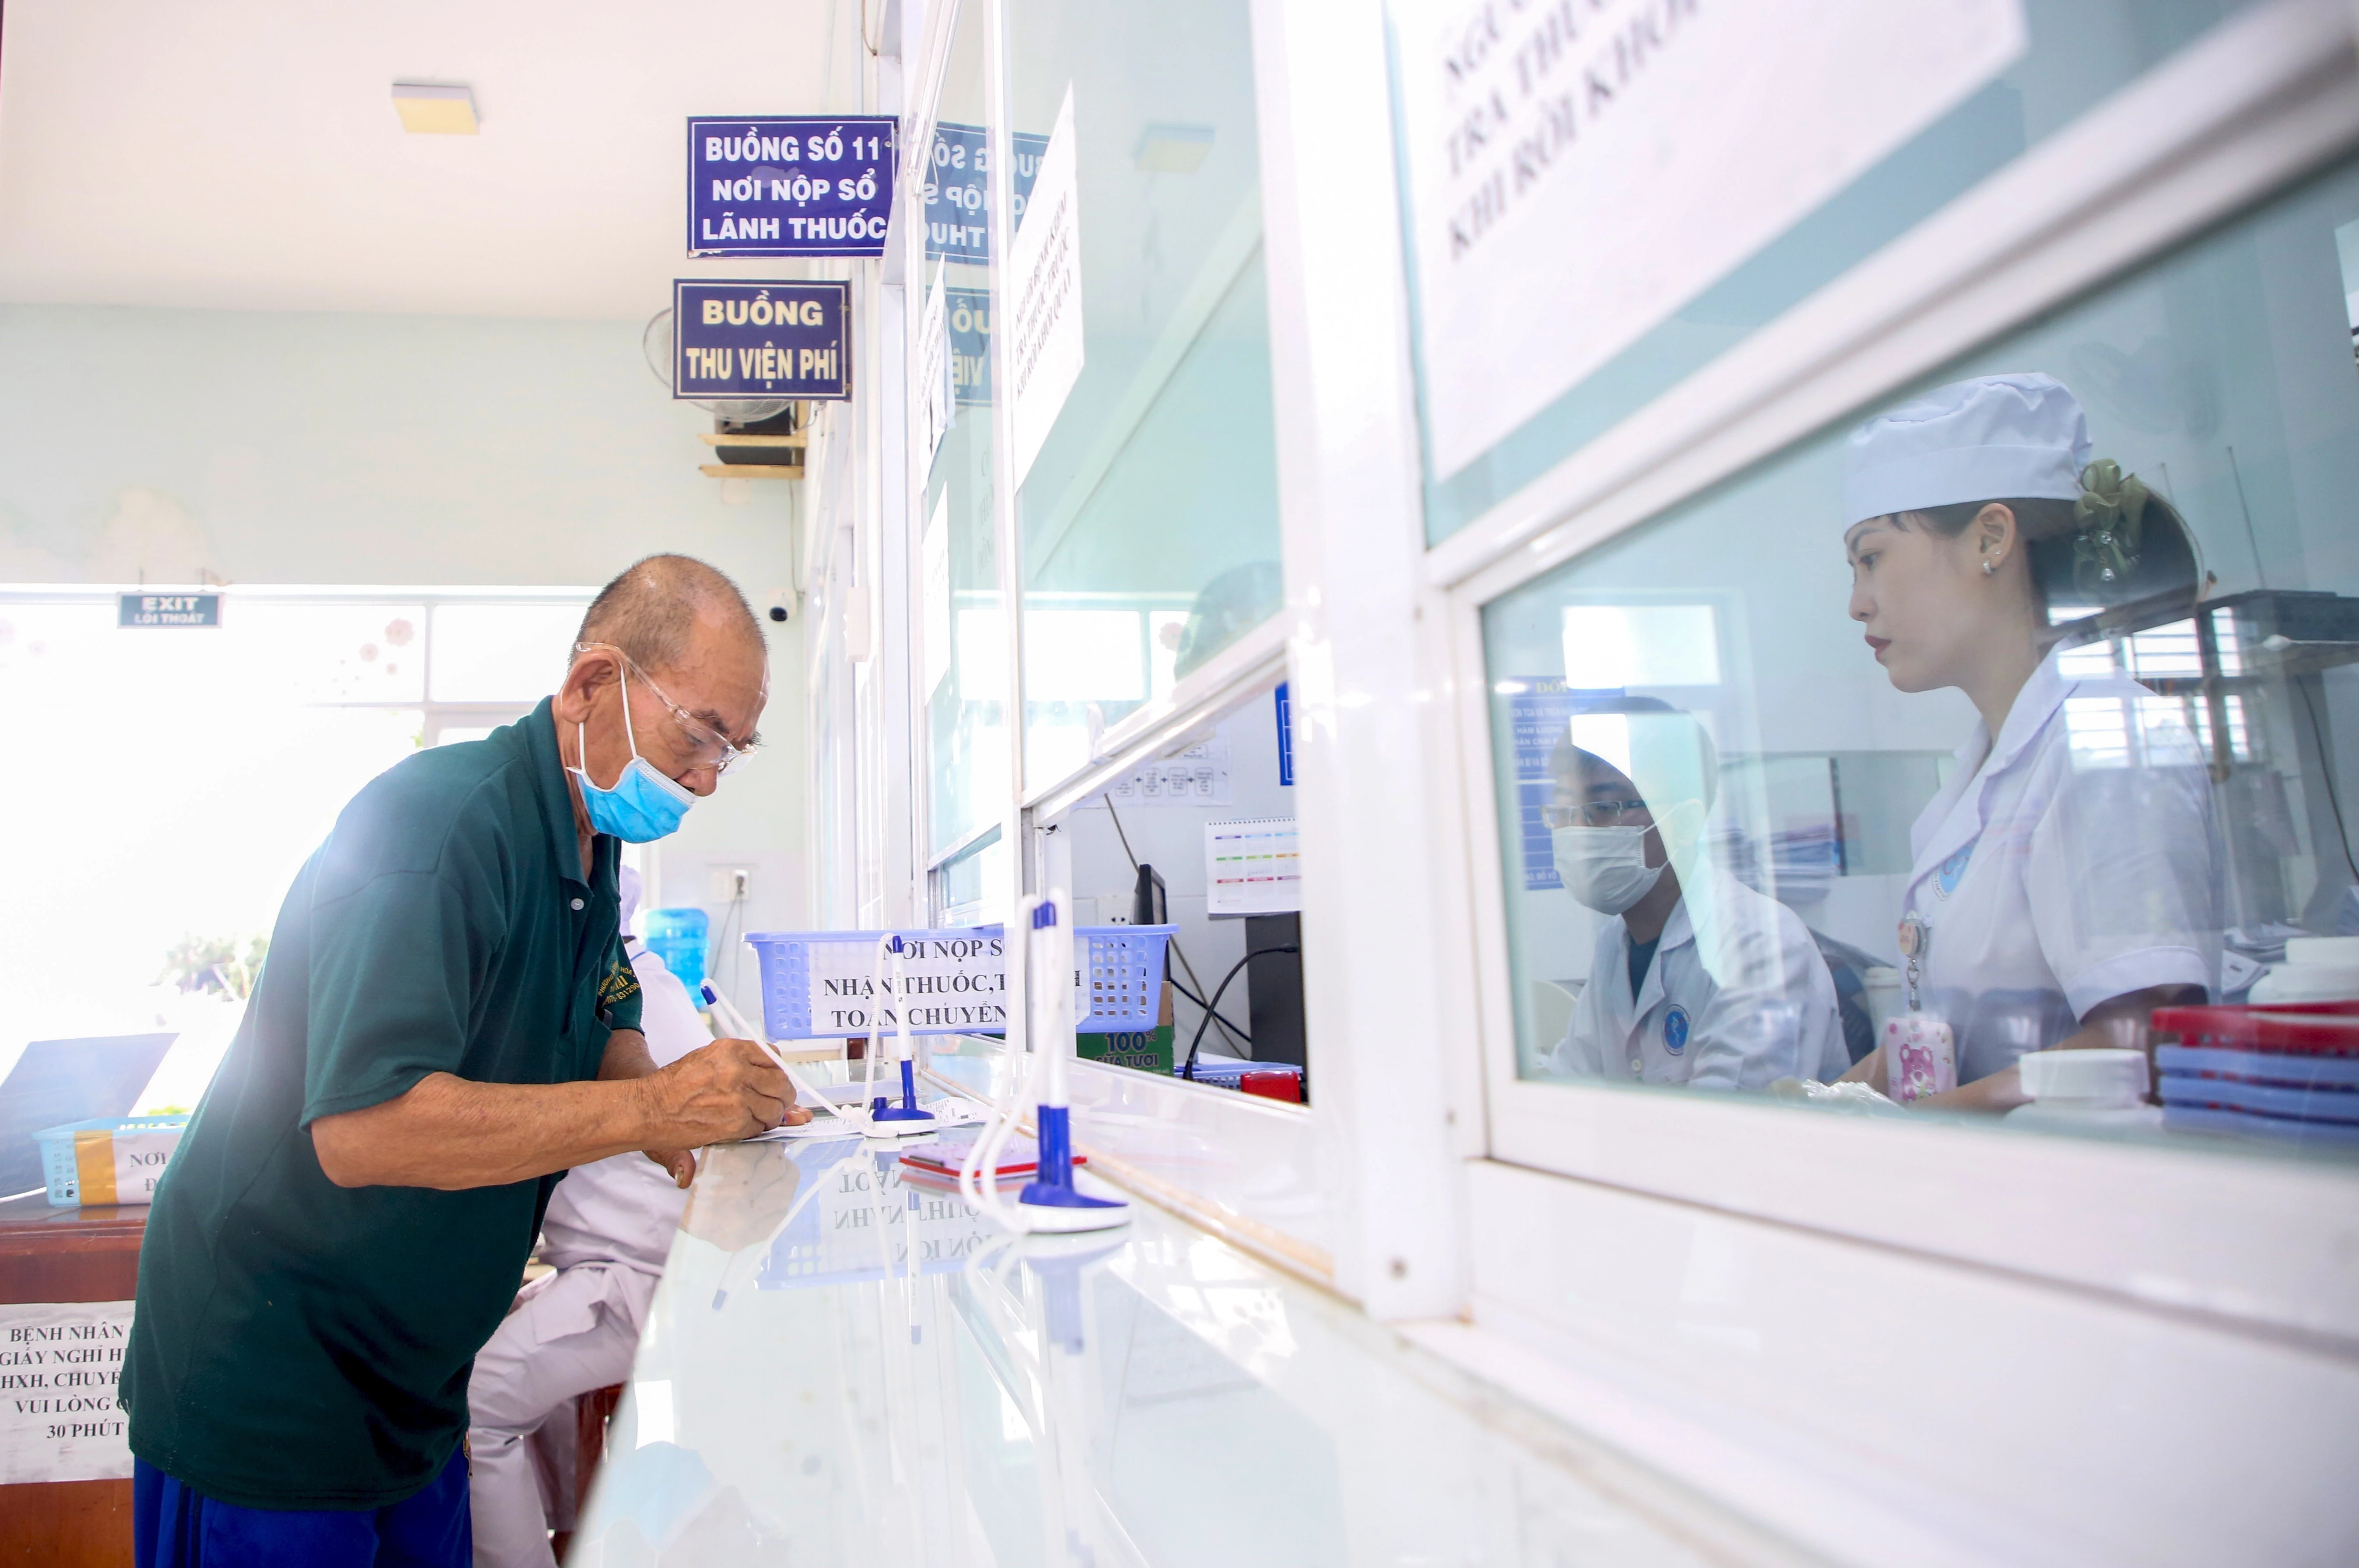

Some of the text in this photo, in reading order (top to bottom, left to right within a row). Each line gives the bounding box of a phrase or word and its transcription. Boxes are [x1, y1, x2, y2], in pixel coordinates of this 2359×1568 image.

[706, 126, 879, 162] BUỒNG SỐ 11
[712, 168, 875, 207] NƠI NỘP SỔ
[702, 208, 887, 240] LÃNH THUỐC
[1447, 168, 1507, 263] KHI
[702, 290, 823, 326] BUỒNG
[686, 341, 837, 388] THU VIỆN PHÍ
[142, 596, 199, 611] EXIT
[883, 938, 1003, 962] NƠI NỘP S
[823, 975, 893, 1000] NHẬN
[1125, 1053, 1159, 1068] TƯƠI
[129, 1152, 167, 1167] NƠI
[10, 1321, 124, 1345] BỆNH NHÂN
[0, 1344, 126, 1365] GIẤY NGHỈ H
[15, 1399, 49, 1414] VUI
[55, 1394, 111, 1413] LÒNG
[47, 1418, 124, 1439] 30 PHÚT
